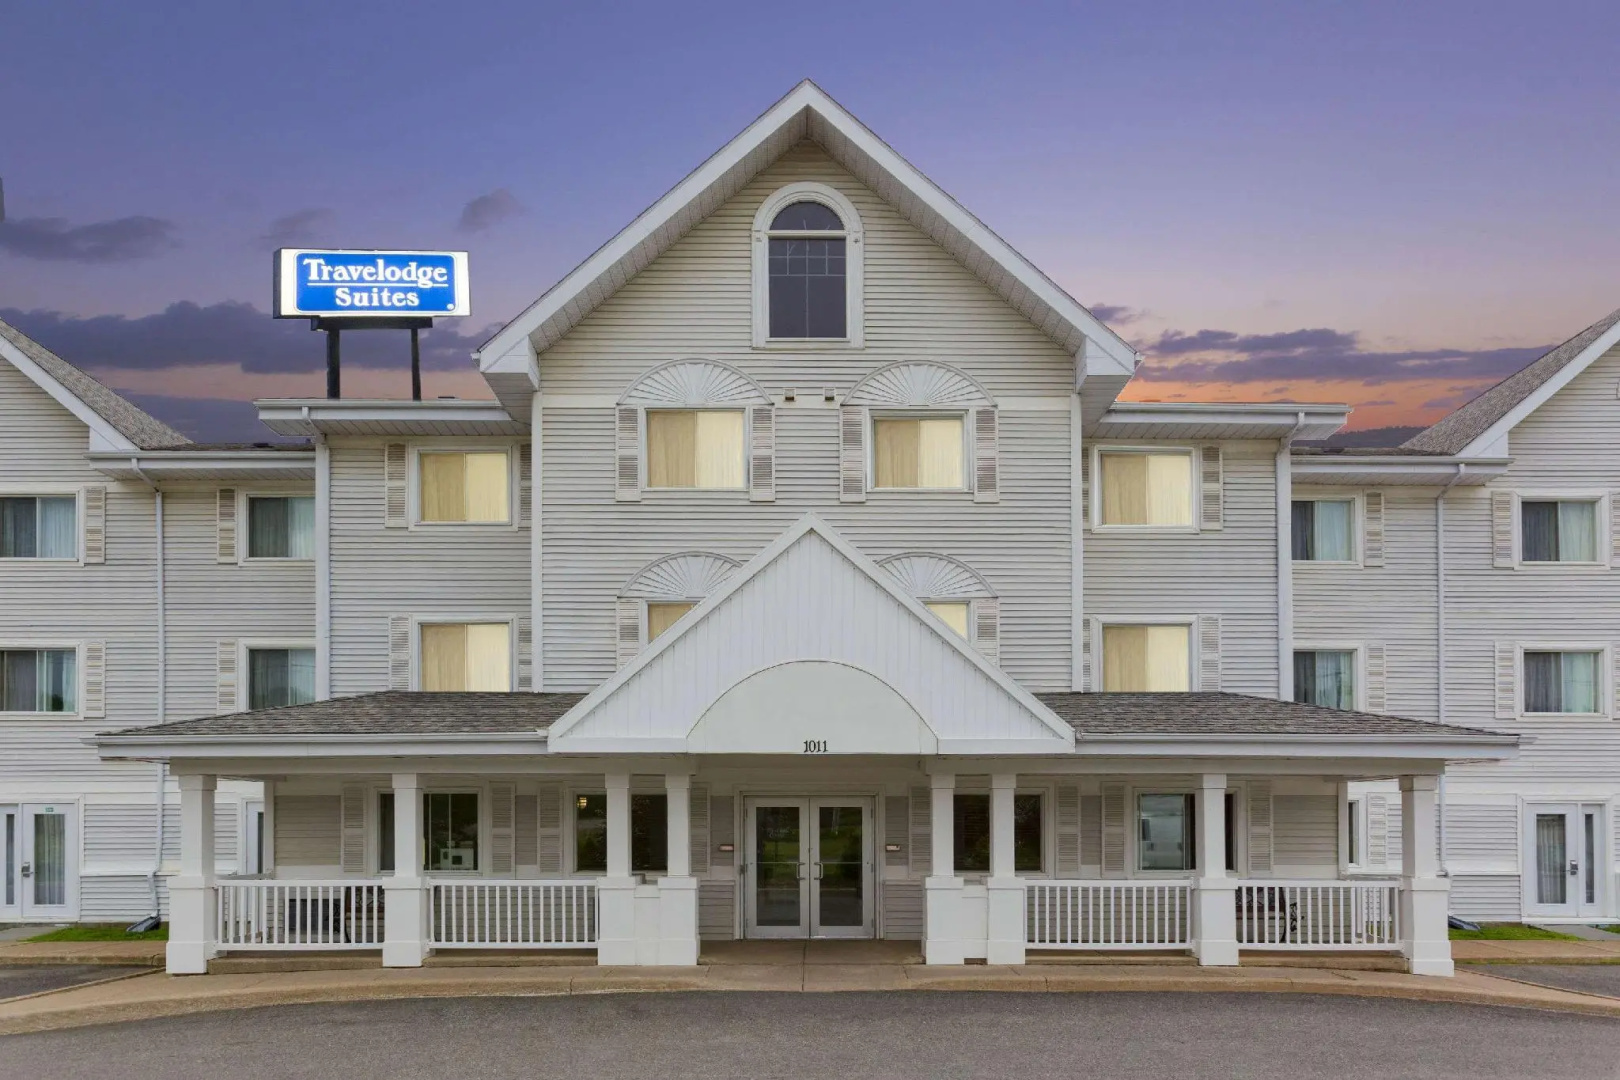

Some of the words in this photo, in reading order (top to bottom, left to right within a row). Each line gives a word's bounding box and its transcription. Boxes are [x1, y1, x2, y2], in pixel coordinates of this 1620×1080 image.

[303, 258, 448, 288] Travelodge
[335, 287, 420, 307] Suites
[803, 739, 828, 753] 1011
